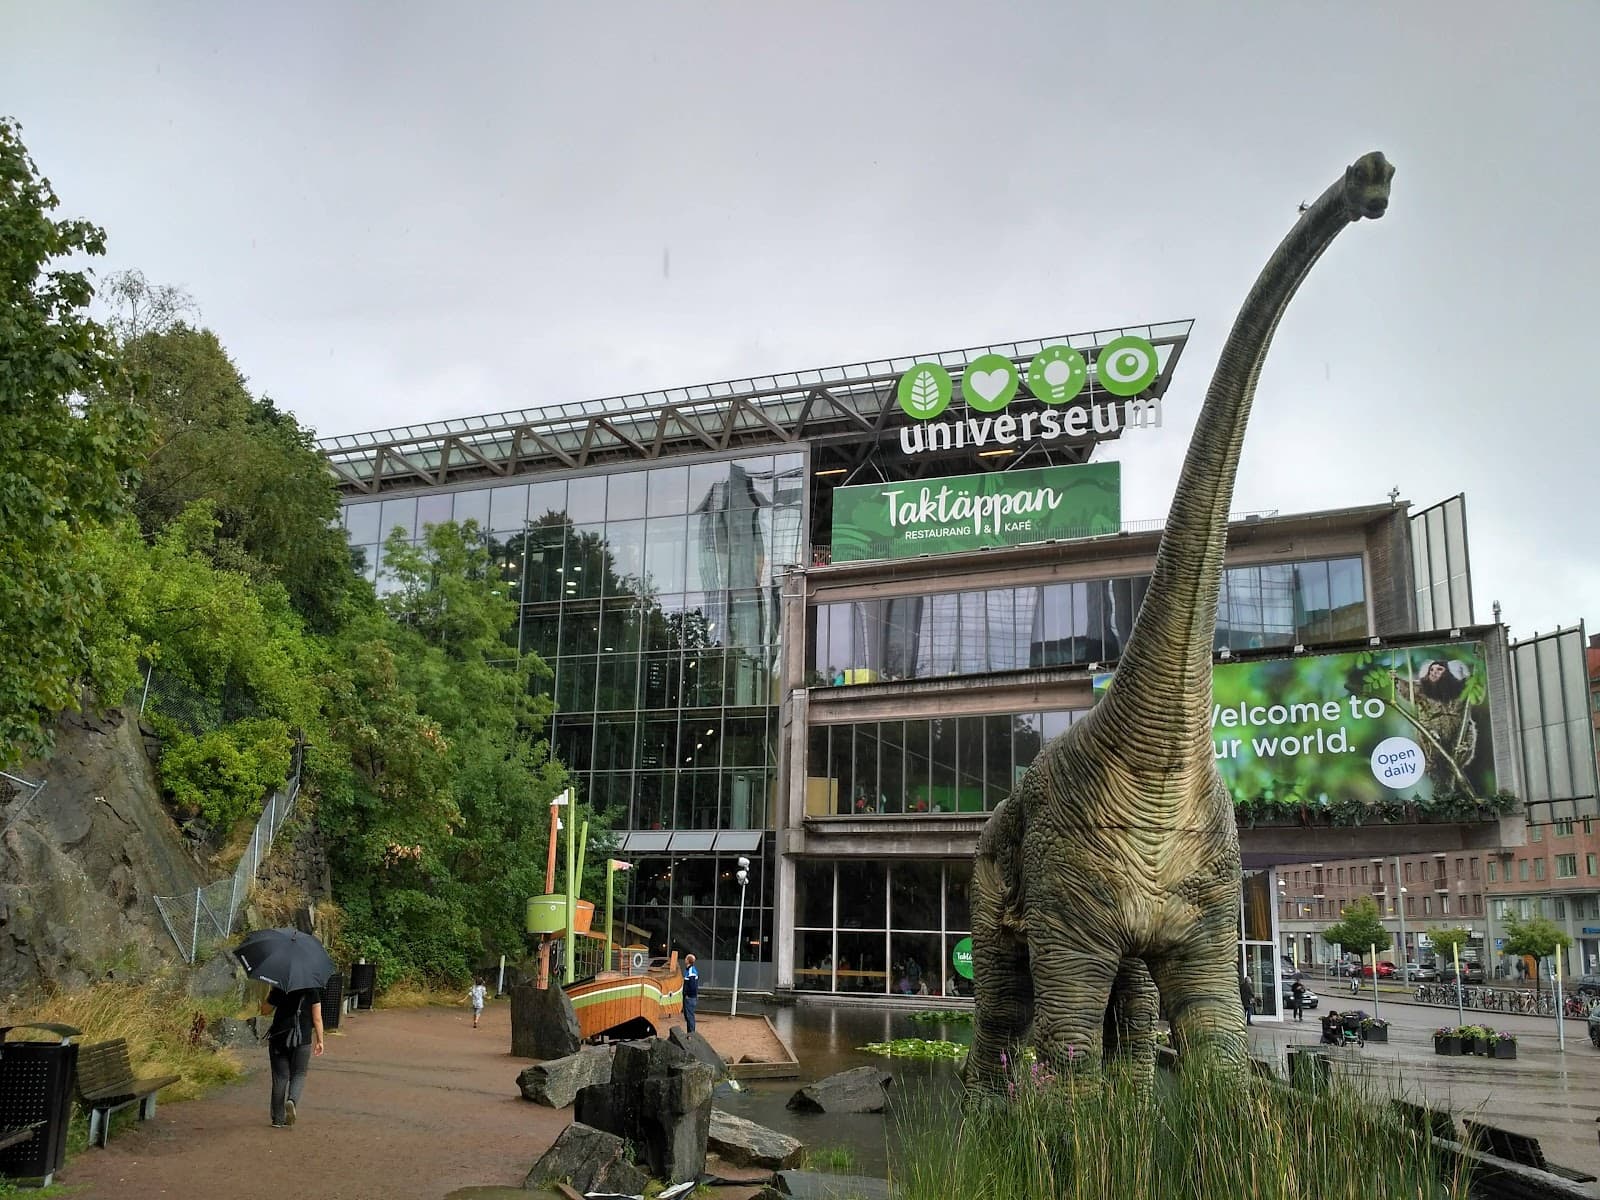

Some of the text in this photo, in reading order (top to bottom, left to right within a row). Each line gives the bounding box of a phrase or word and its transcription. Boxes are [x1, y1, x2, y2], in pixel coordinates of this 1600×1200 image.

[900, 397, 1163, 455] universeum
[882, 485, 1063, 536] Taktäppan
[905, 519, 1032, 541] RESTAURANG & KAFÉ
[1349, 695, 1386, 720] to
[1212, 726, 1356, 759] ur world.
[1377, 747, 1416, 767] Open
[1384, 761, 1417, 779] daily
